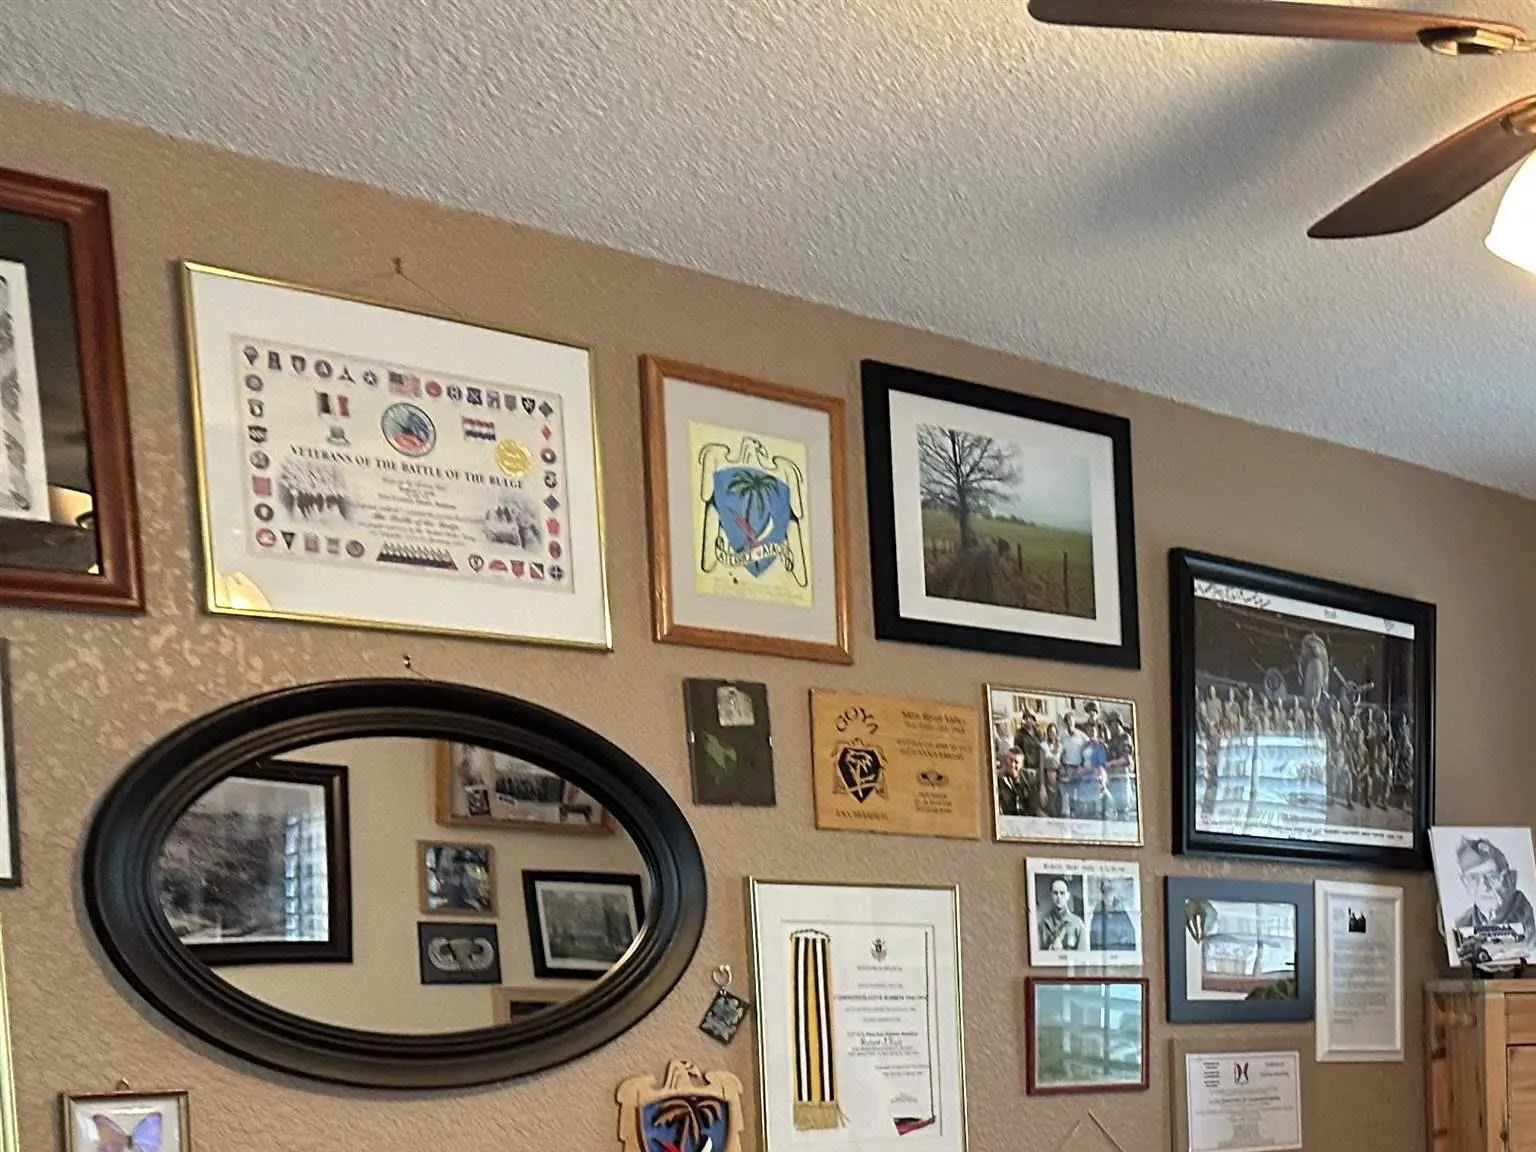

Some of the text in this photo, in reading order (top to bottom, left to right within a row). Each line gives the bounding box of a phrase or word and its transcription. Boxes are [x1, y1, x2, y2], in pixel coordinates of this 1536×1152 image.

[290, 444, 524, 489] VETERANS OF THE BATTLE OF THE BULGE
[836, 706, 879, 735] GOYA
